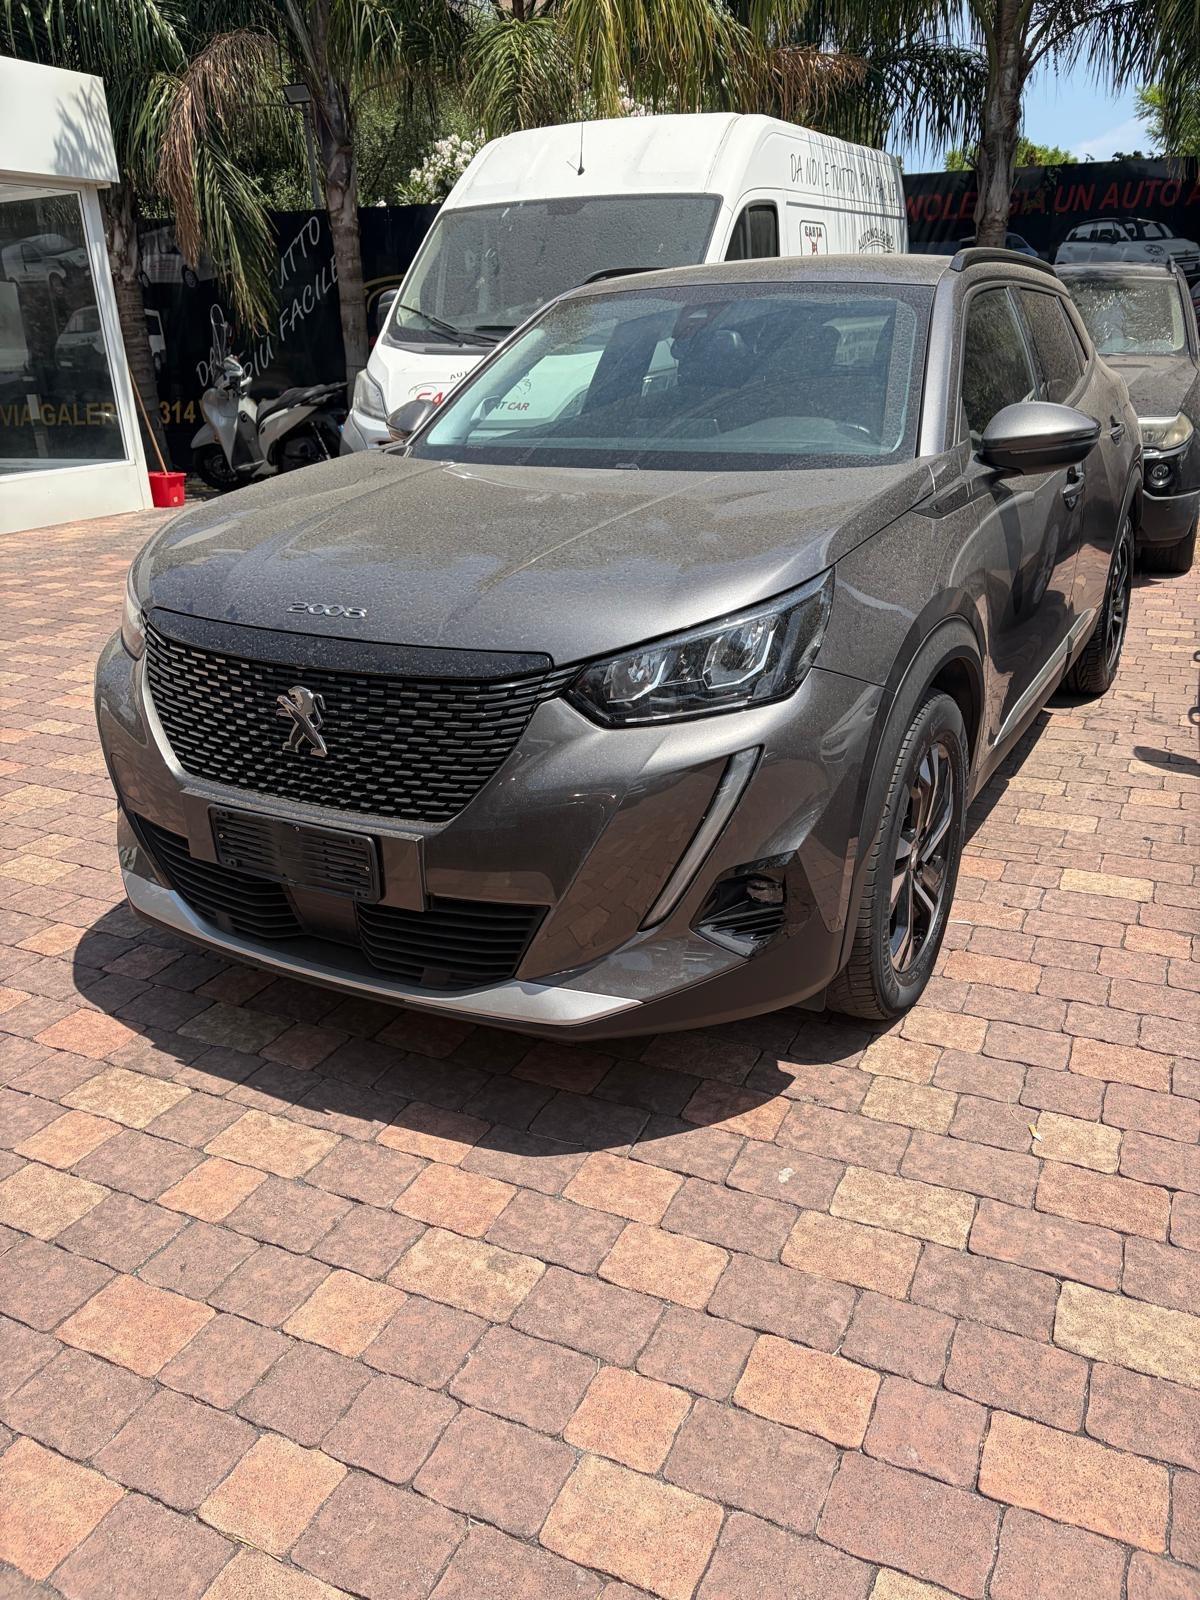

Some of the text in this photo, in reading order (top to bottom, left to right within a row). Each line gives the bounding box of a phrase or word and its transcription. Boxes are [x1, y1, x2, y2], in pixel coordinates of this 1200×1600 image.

[790, 153, 803, 183] DA
[806, 157, 820, 186] NOI
[906, 186, 1046, 222] NOLEGIA
[1054, 183, 1095, 213] UN
[1098, 179, 1182, 210] AUTO
[804, 225, 823, 238] CARTA
[0, 403, 37, 427] VIA
[40, 402, 118, 427] GALER
[160, 401, 196, 424] 314
[508, 402, 530, 411] CAR
[286, 601, 367, 619] 2008
